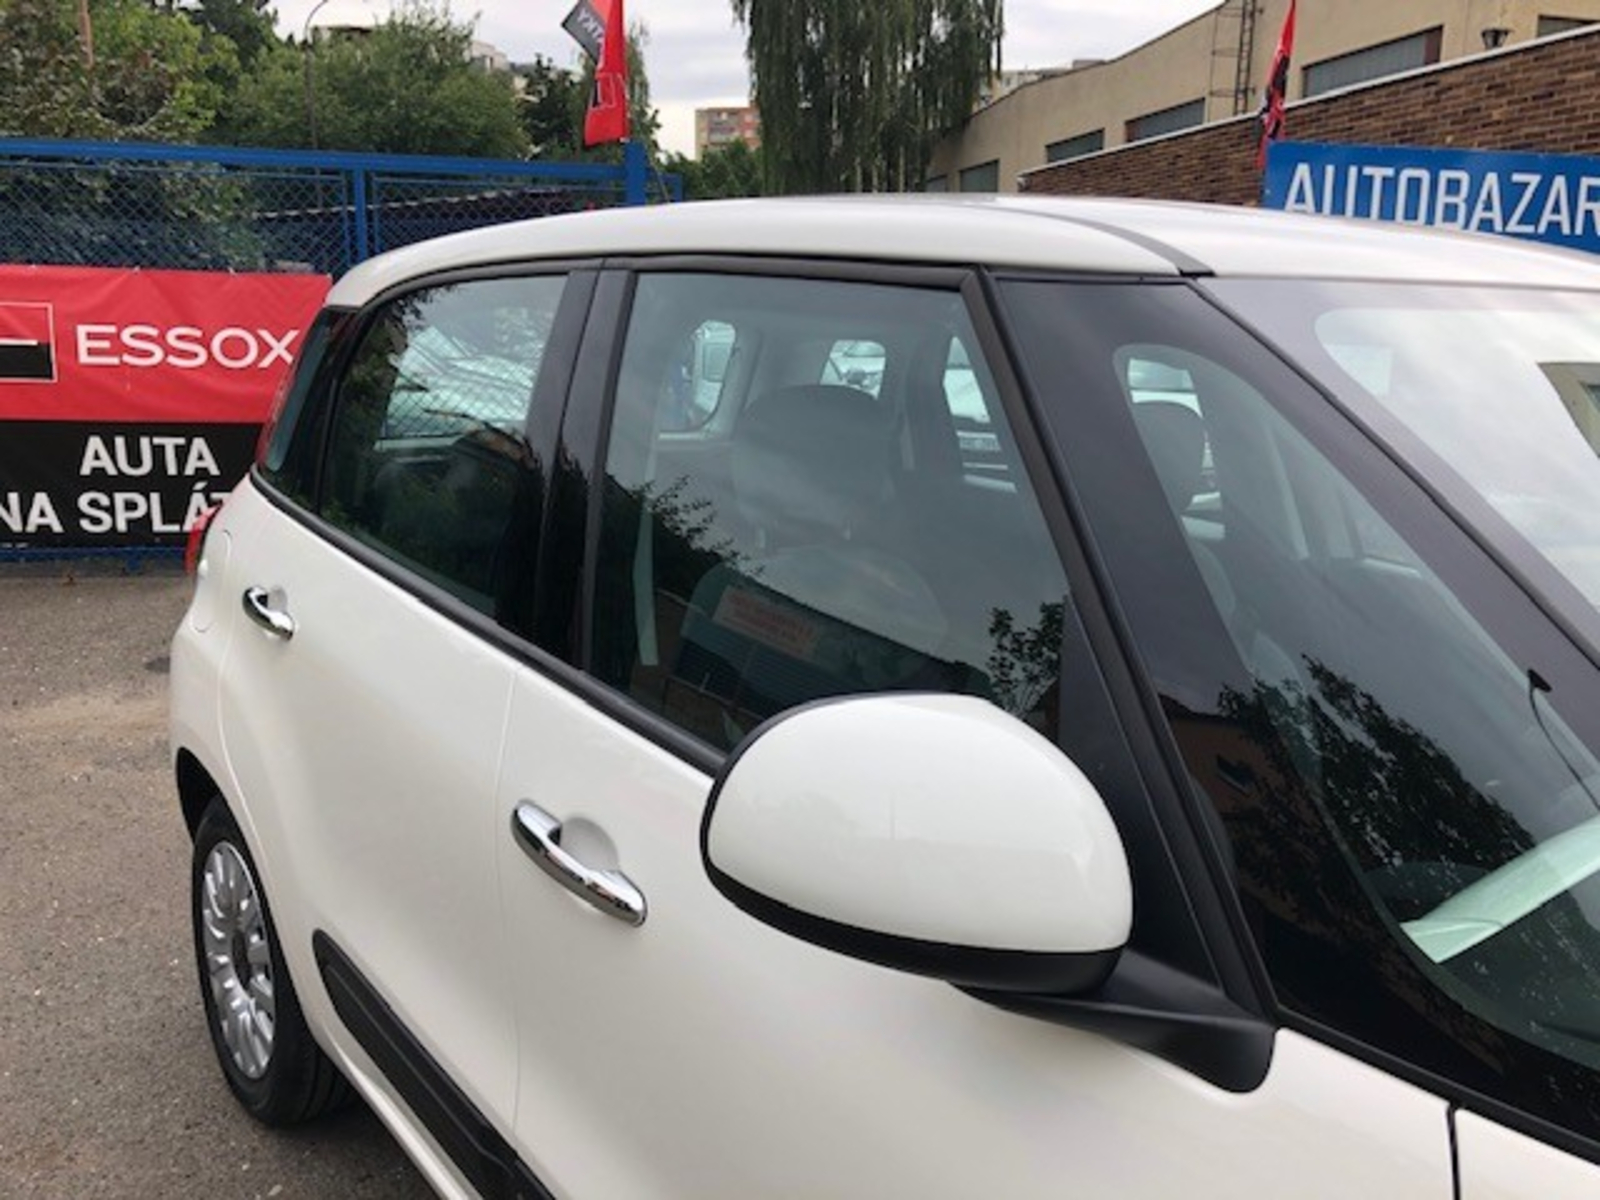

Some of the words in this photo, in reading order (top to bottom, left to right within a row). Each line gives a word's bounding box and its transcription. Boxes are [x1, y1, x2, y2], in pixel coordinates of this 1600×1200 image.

[1284, 162, 1600, 236] AUTOBAZAR
[75, 324, 299, 368] ESSOX
[79, 435, 220, 476] AUTA
[77, 481, 232, 533] SPLÁ
